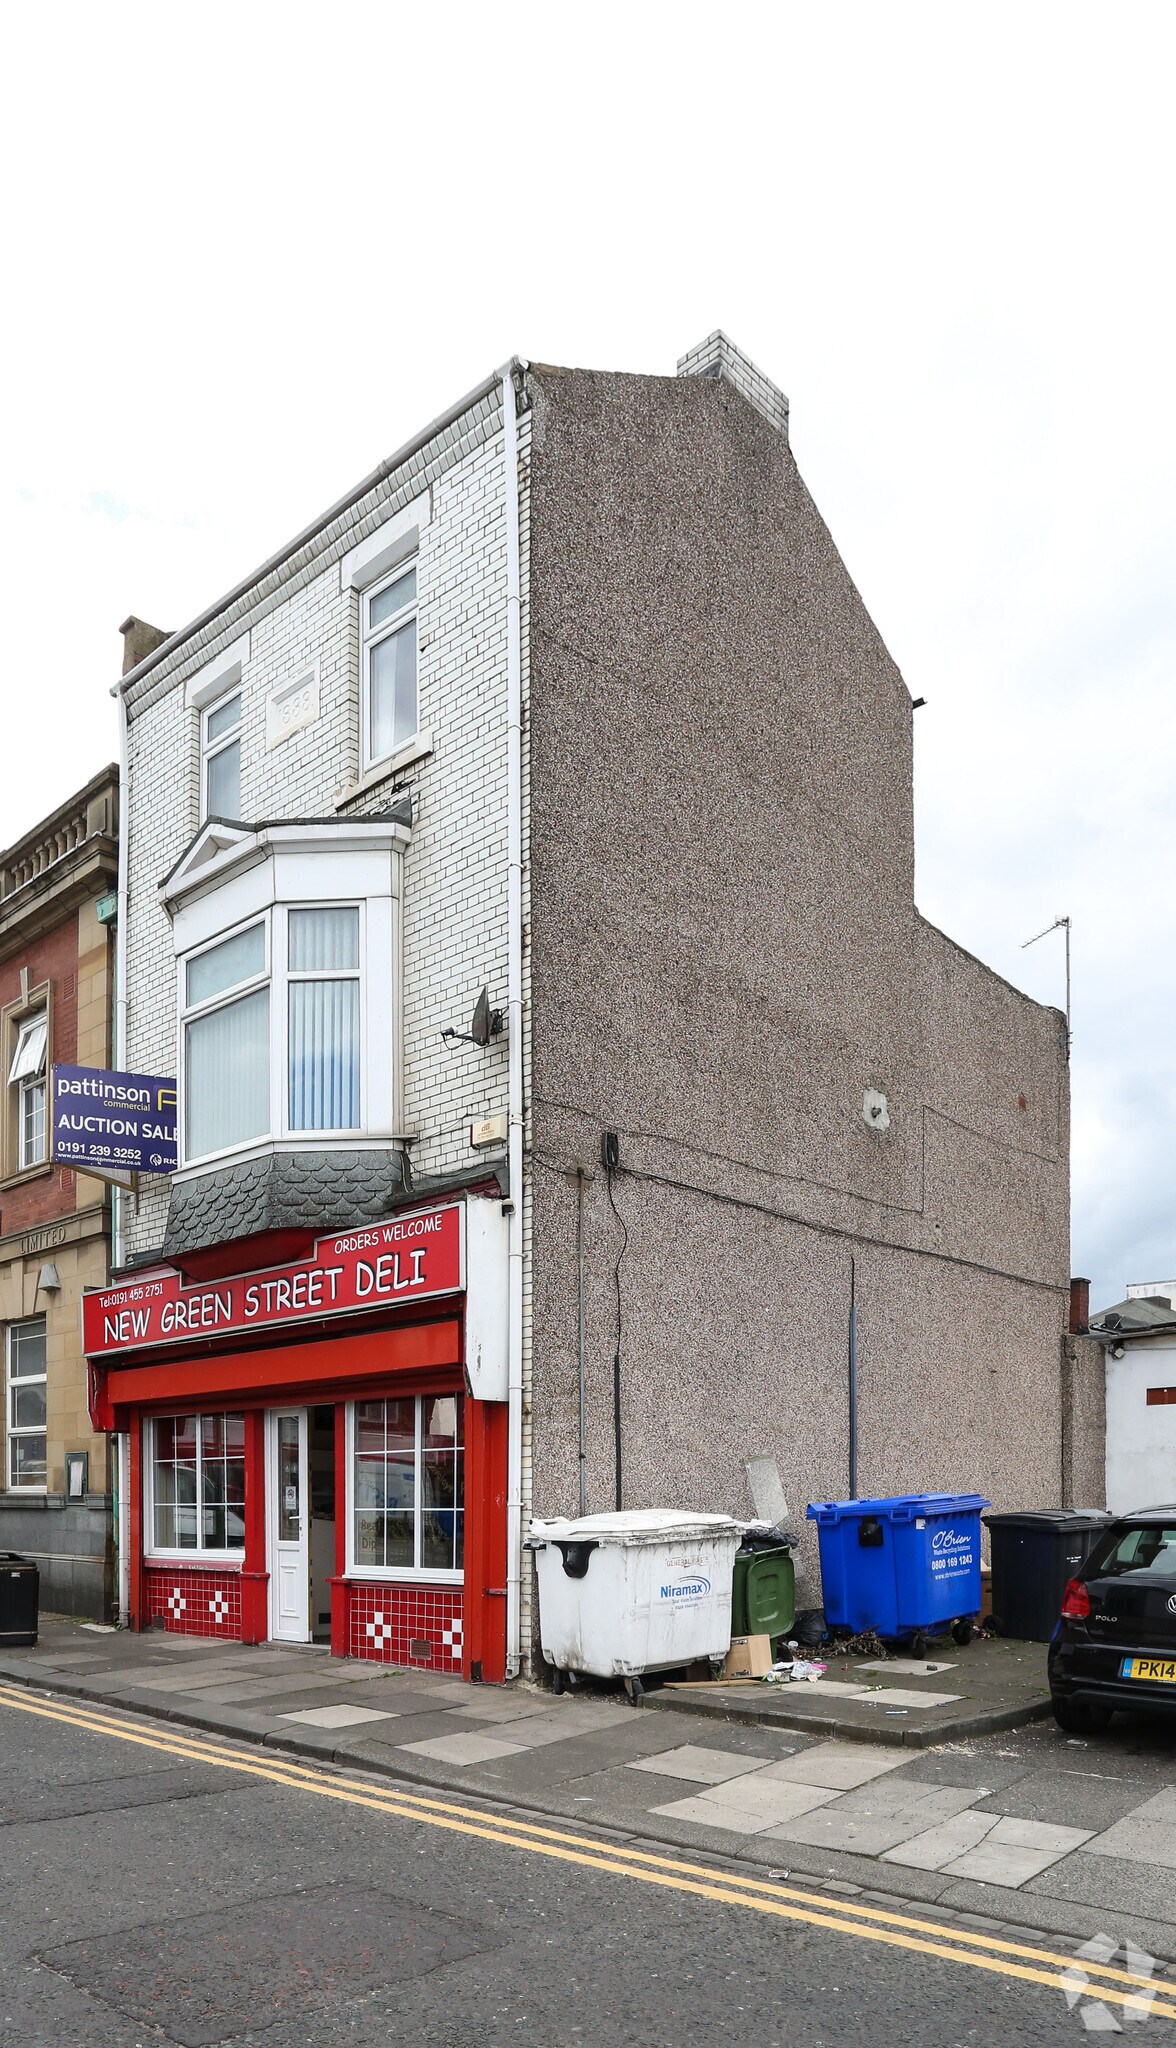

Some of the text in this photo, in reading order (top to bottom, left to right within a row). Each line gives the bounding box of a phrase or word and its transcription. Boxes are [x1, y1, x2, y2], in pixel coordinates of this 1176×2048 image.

[58, 1078, 150, 1103] pattinson
[103, 1100, 151, 1111] commercial
[58, 1114, 137, 1136] AUCTION
[58, 1141, 141, 1160] 0191 239 3252
[20, 1226, 66, 1254] LIMITED
[334, 1214, 443, 1255] ORDERS WELCOME
[104, 1249, 427, 1344] NEW GREEN STREET DELI
[129, 1287, 144, 1300] 455
[145, 1283, 163, 1297] 2751
[931, 1554, 973, 1570] 0800 169 1243
[660, 1584, 703, 1598] Niramax
[1095, 1614, 1118, 1622] POLO
[1138, 1661, 1175, 1678] PK14
